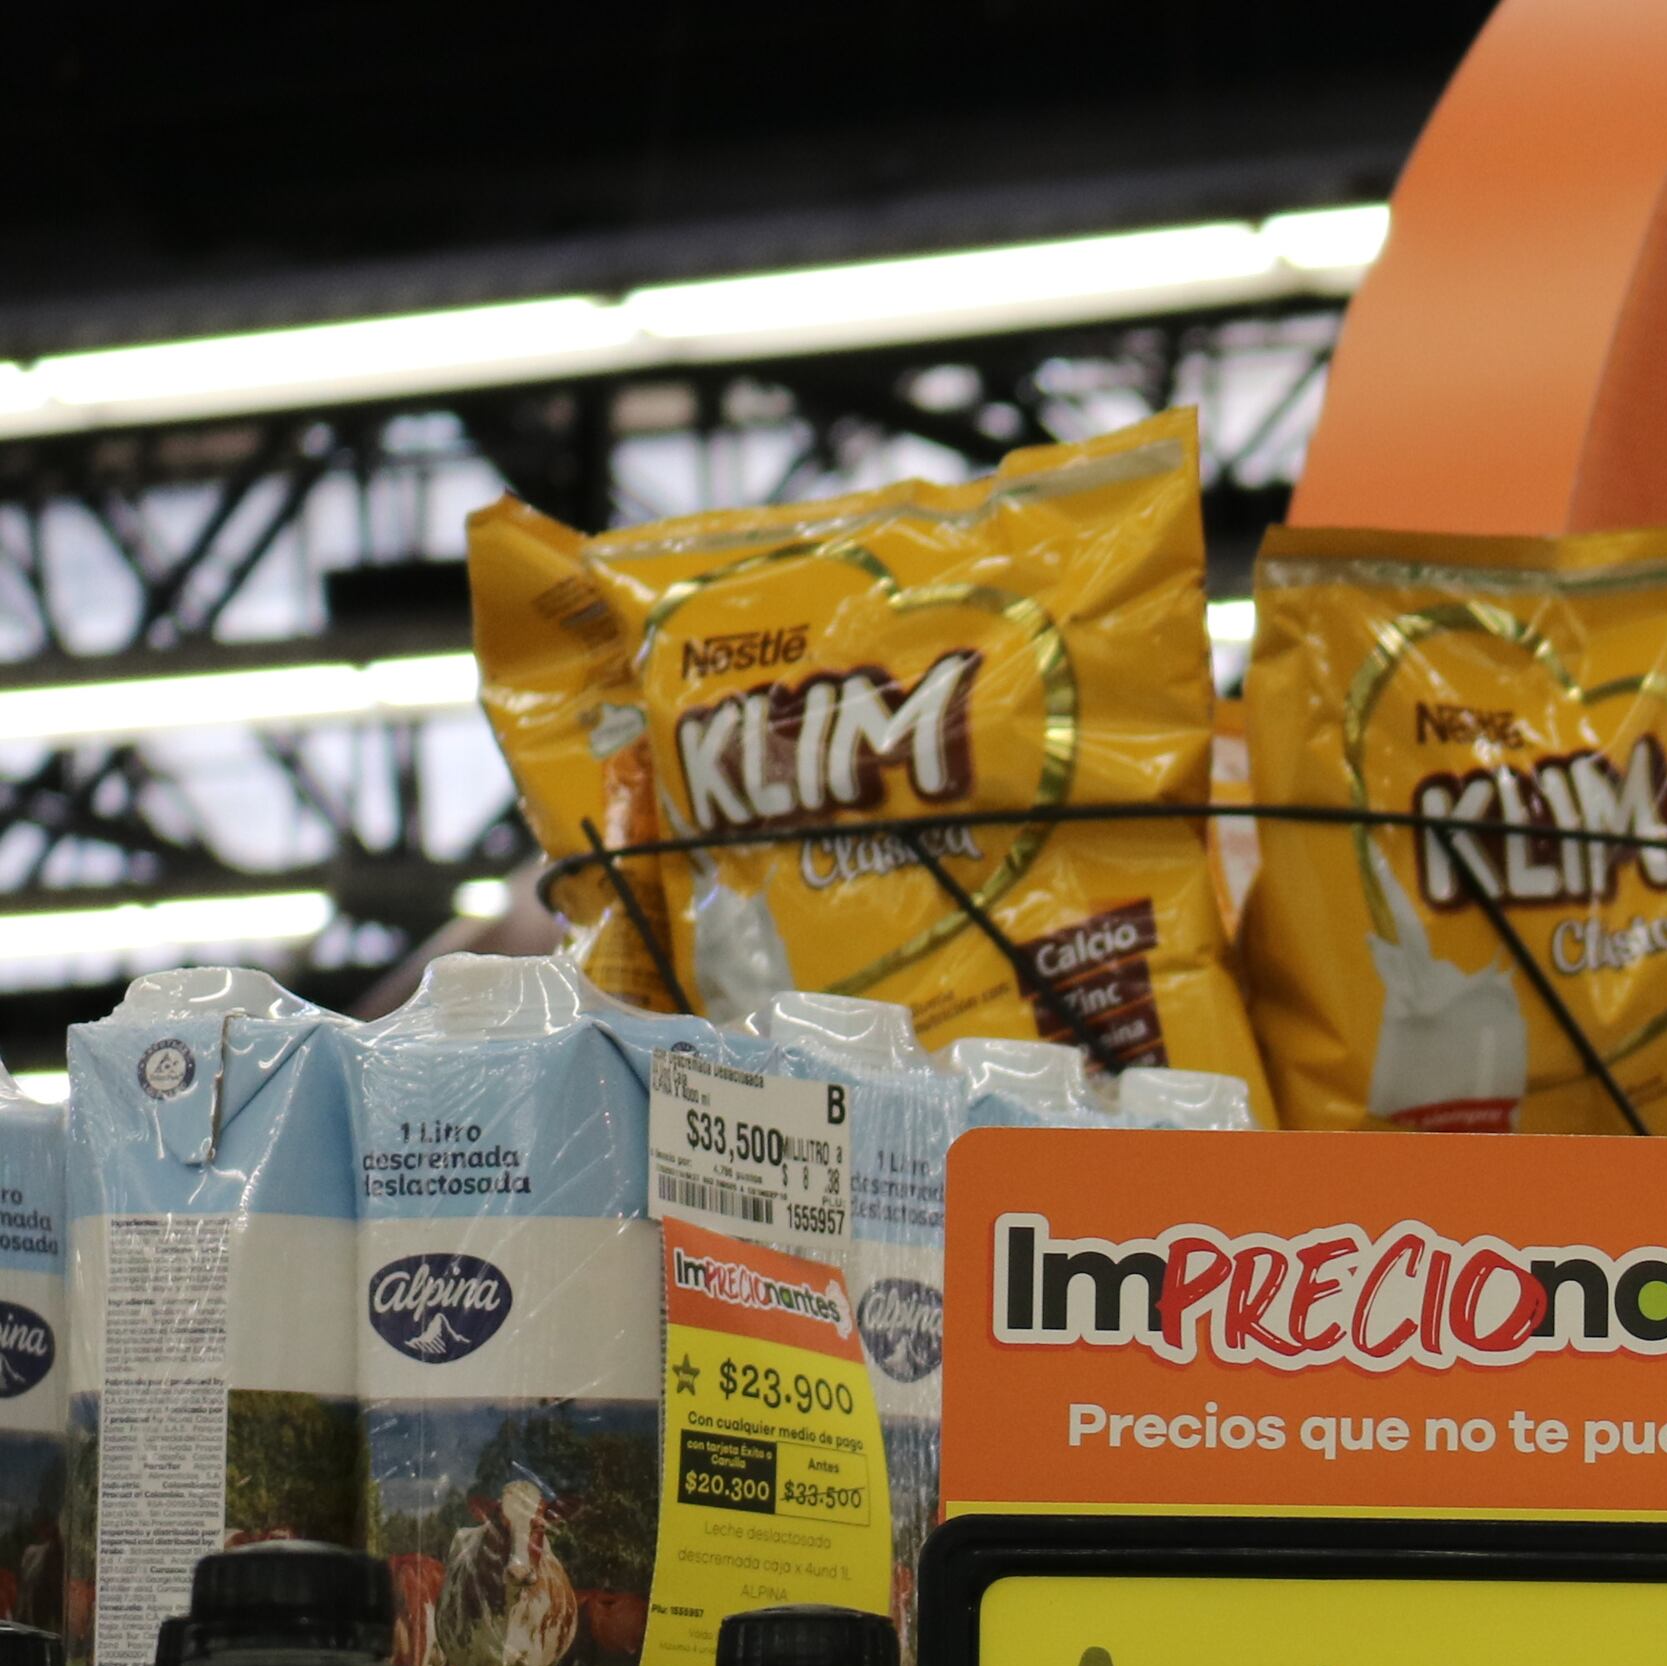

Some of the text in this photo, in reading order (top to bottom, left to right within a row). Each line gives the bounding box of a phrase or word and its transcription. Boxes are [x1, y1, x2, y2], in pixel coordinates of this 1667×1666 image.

[678, 651, 980, 832] KLIM
[1035, 922, 1138, 978] Calcio
[827, 1083, 846, 1125] B
[686, 1108, 785, 1167] $33,500
[787, 1203, 846, 1236] 1555957
[719, 1358, 854, 1416] $23.900
[687, 1410, 864, 1452] Con cualquier medio de pago
[1068, 1402, 1286, 1450] Precios
[1300, 1416, 1410, 1460] que
[1425, 1418, 1496, 1452] no
[1508, 1410, 1569, 1454] te
[807, 1457, 840, 1474] Antes
[684, 1469, 771, 1502] $20.300
[783, 1479, 862, 1509] $33.500
[704, 1520, 832, 1550] Leche deslactosada
[678, 1547, 760, 1571] descremada
[763, 1558, 792, 1575] caja
[740, 1584, 788, 1601] ALPINA
